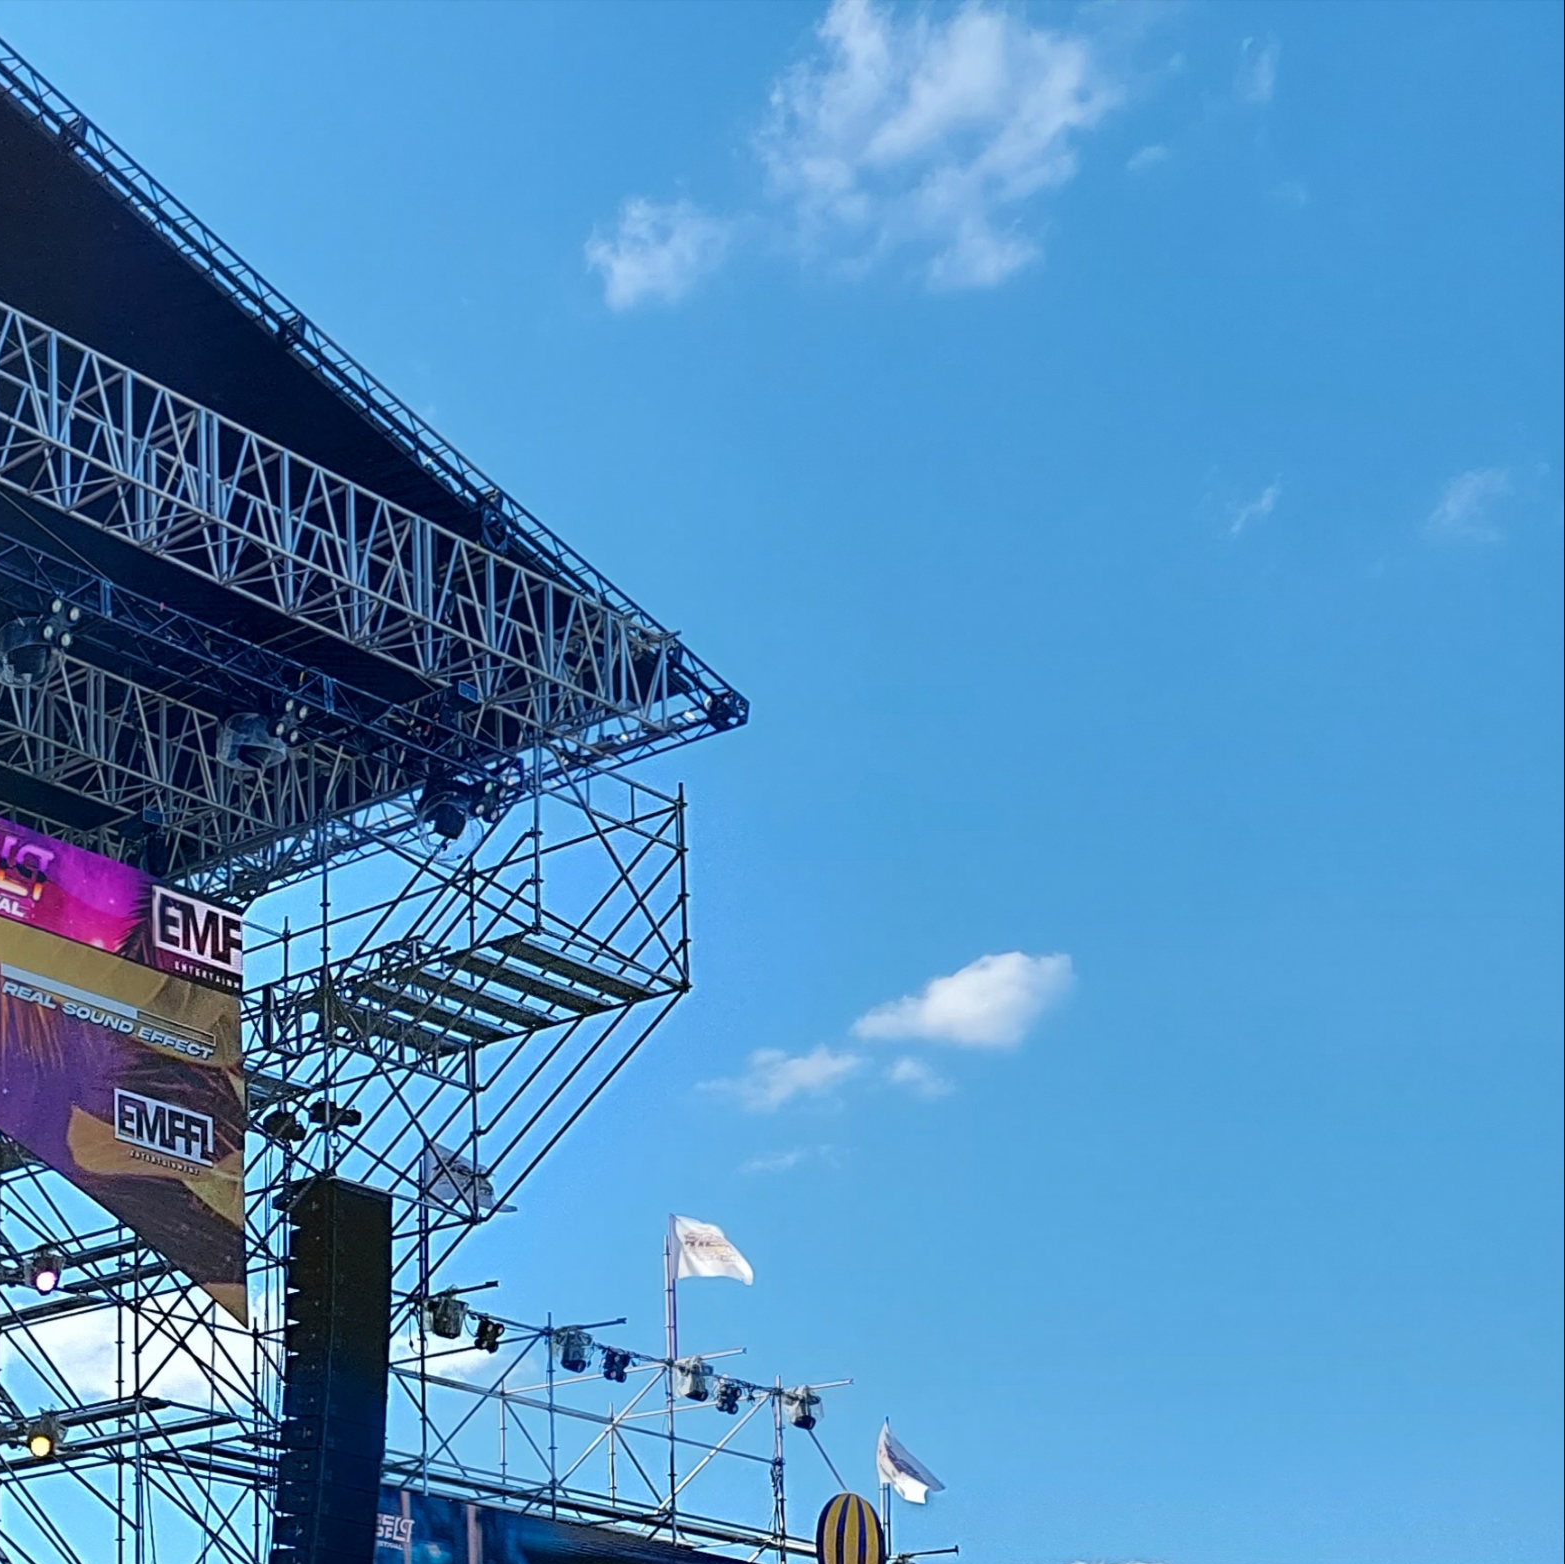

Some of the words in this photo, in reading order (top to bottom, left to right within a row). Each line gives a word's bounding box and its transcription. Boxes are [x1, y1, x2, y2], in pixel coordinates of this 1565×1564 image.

[174, 960, 240, 989] ENTERTAINM
[2, 979, 56, 1010] REAL
[62, 1001, 135, 1036] SOUND
[138, 1026, 215, 1060] EFFECT
